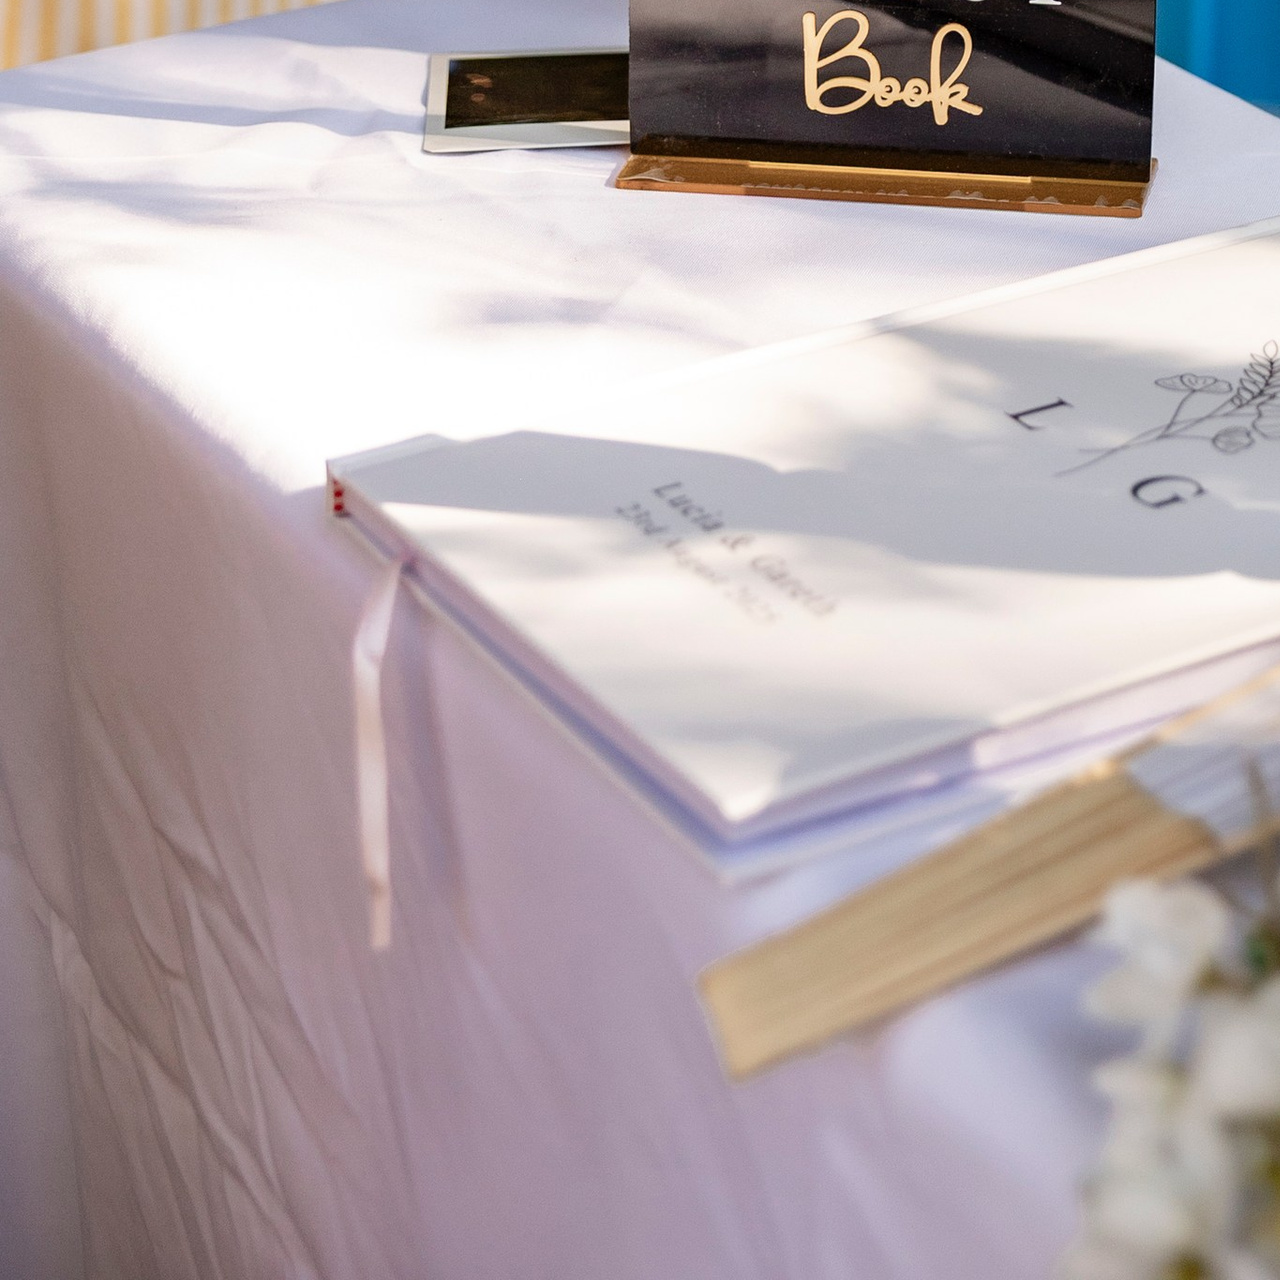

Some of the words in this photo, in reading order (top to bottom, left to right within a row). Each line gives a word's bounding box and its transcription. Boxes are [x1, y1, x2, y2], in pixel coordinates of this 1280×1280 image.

[802, 9, 984, 126] Book
[1004, 396, 1074, 432] L
[1131, 474, 1207, 509] G
